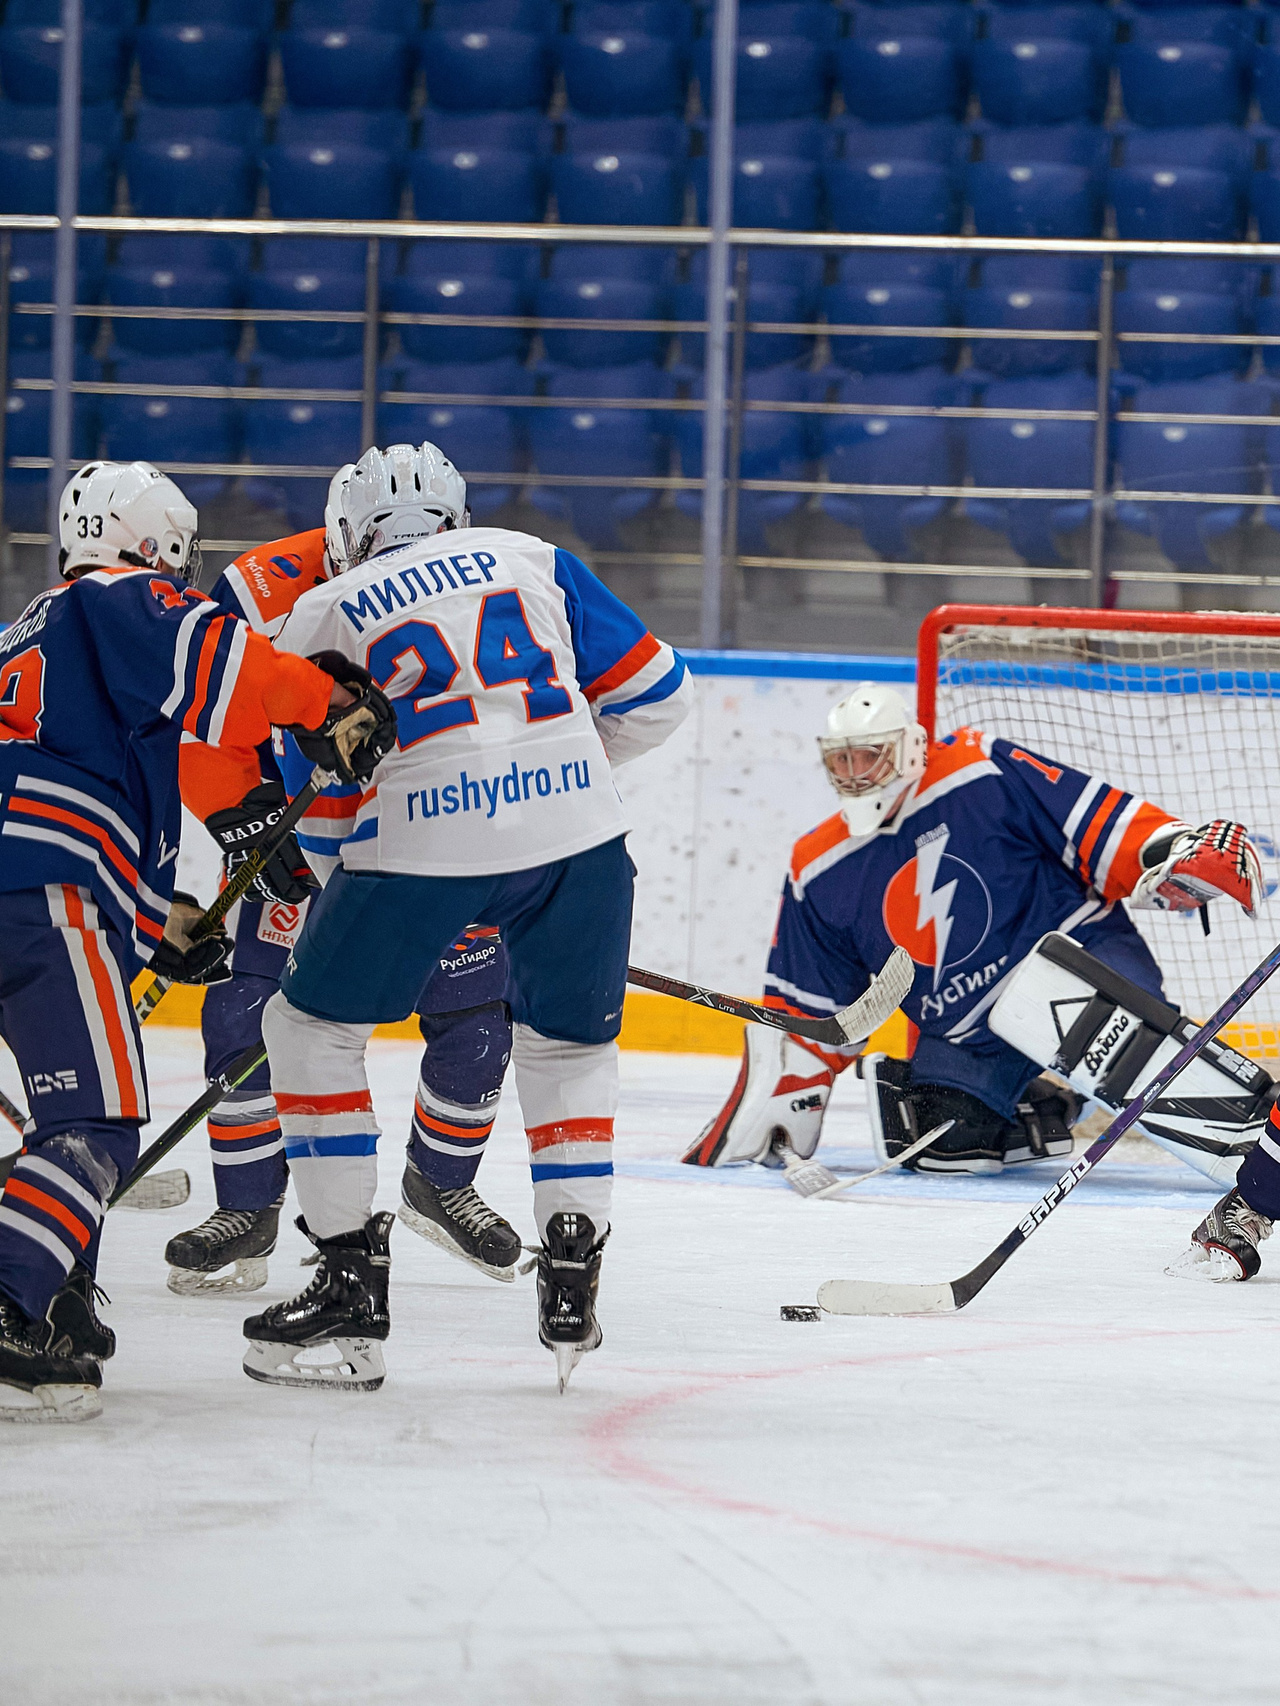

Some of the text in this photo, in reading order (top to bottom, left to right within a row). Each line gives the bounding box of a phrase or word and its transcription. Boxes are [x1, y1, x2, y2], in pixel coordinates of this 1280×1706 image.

[77, 515, 103, 538] 33
[391, 531, 430, 539] TRUE
[245, 555, 272, 598] РусГидро
[340, 551, 497, 634] МИЛЛЕР
[365, 588, 574, 752] 24
[1009, 748, 1064, 784] 1
[407, 759, 591, 822] rushydro.ru
[220, 806, 288, 844] MADG
[440, 946, 496, 971] РусГидро
